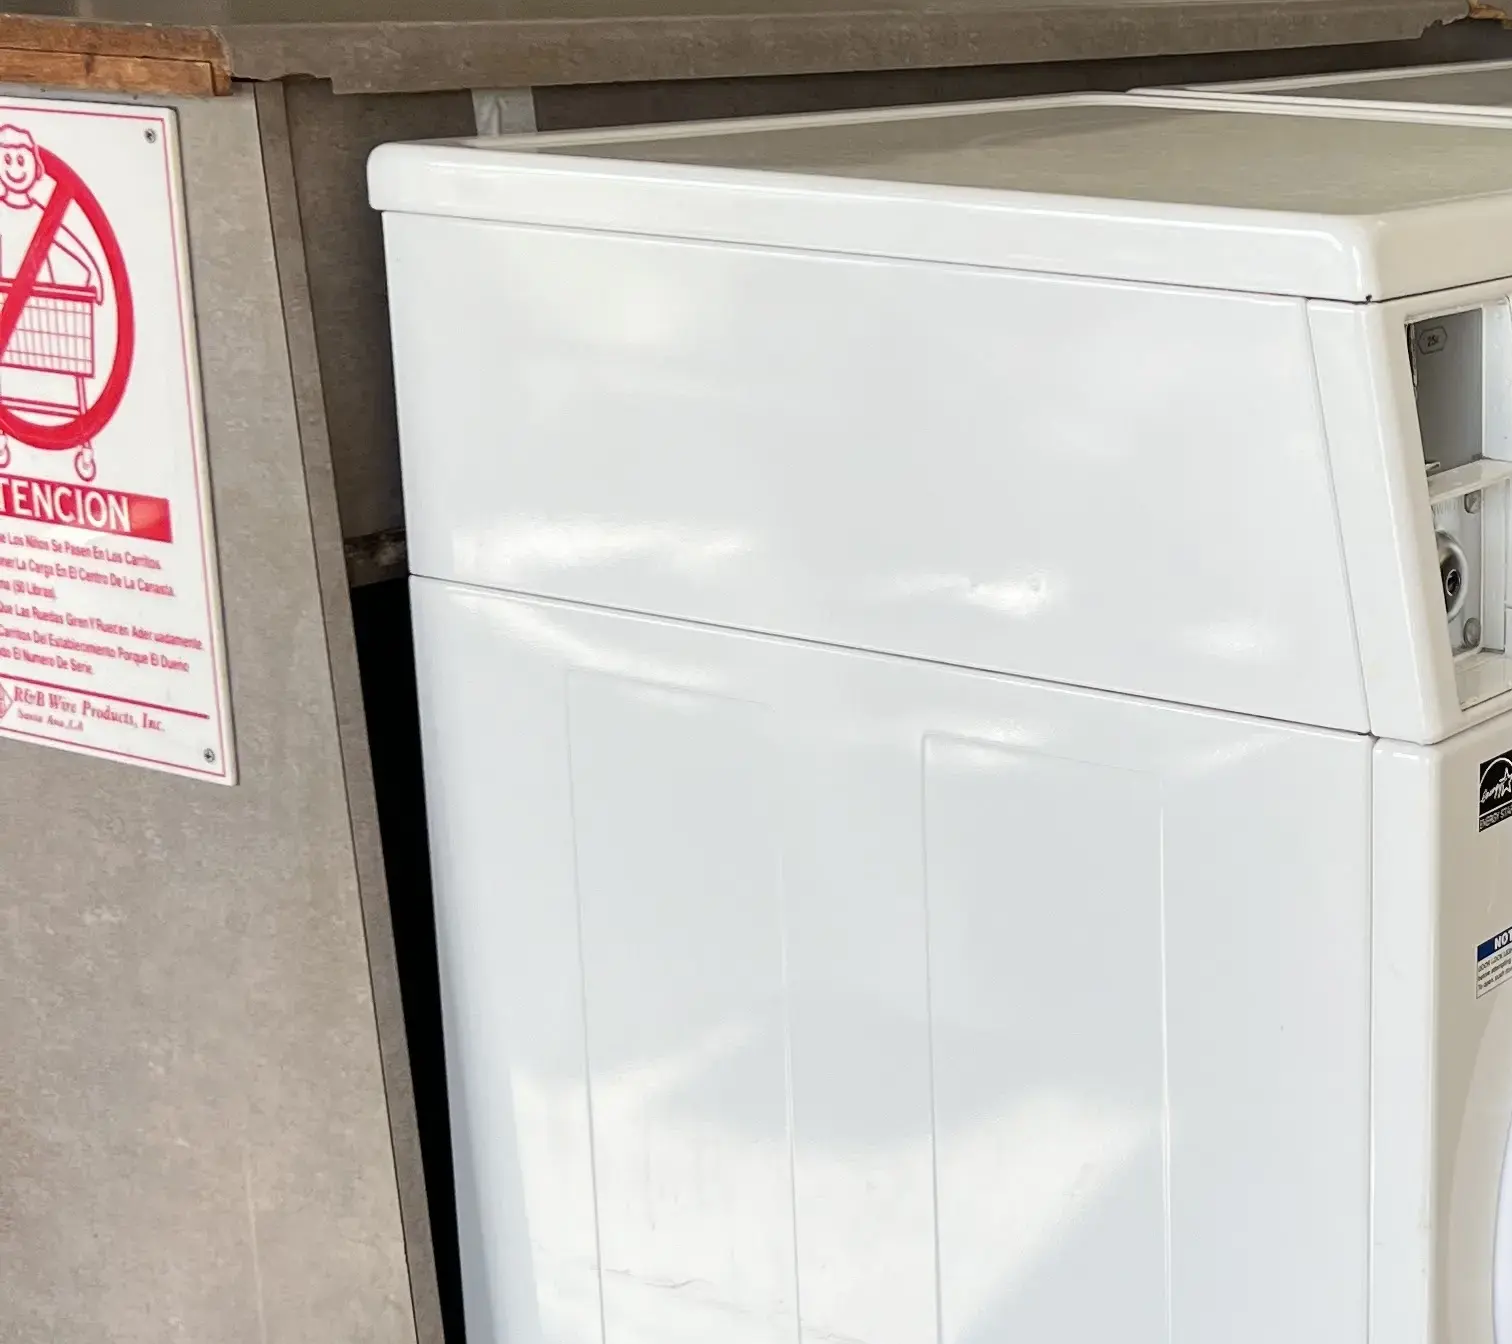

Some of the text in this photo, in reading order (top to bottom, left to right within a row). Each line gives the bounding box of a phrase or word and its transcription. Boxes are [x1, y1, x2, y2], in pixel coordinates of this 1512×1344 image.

[14, 686, 44, 706] R&B
[48, 693, 76, 713] Wire
[81, 699, 137, 728] Products,
